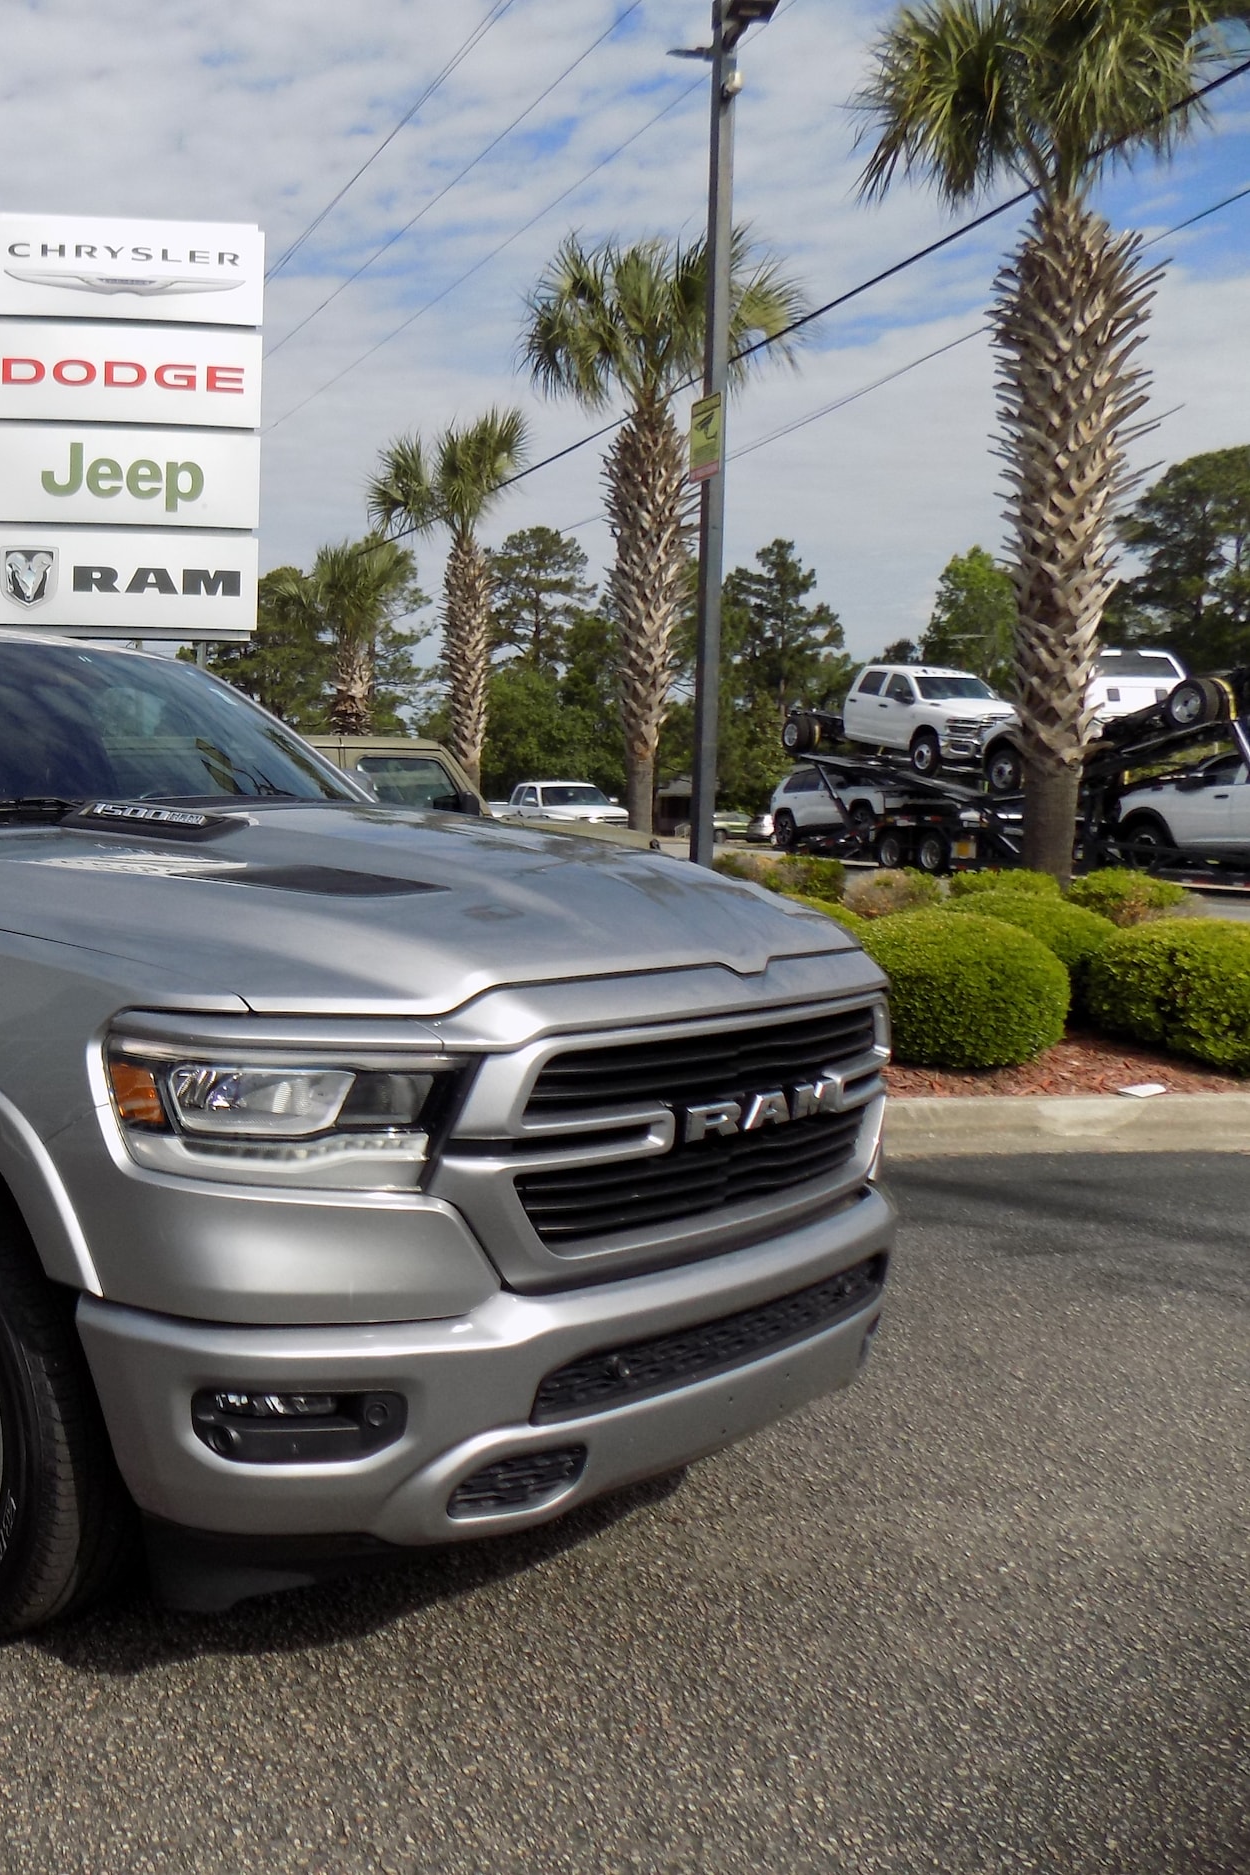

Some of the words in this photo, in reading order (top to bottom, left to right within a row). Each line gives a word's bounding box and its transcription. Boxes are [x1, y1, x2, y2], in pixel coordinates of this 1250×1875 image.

[7, 242, 240, 267] CHRYSLER
[1, 357, 245, 394] DODGE
[41, 442, 205, 512] Jeep
[72, 565, 241, 597] RAM
[92, 803, 170, 821] 1500
[684, 1077, 839, 1143] RAM
